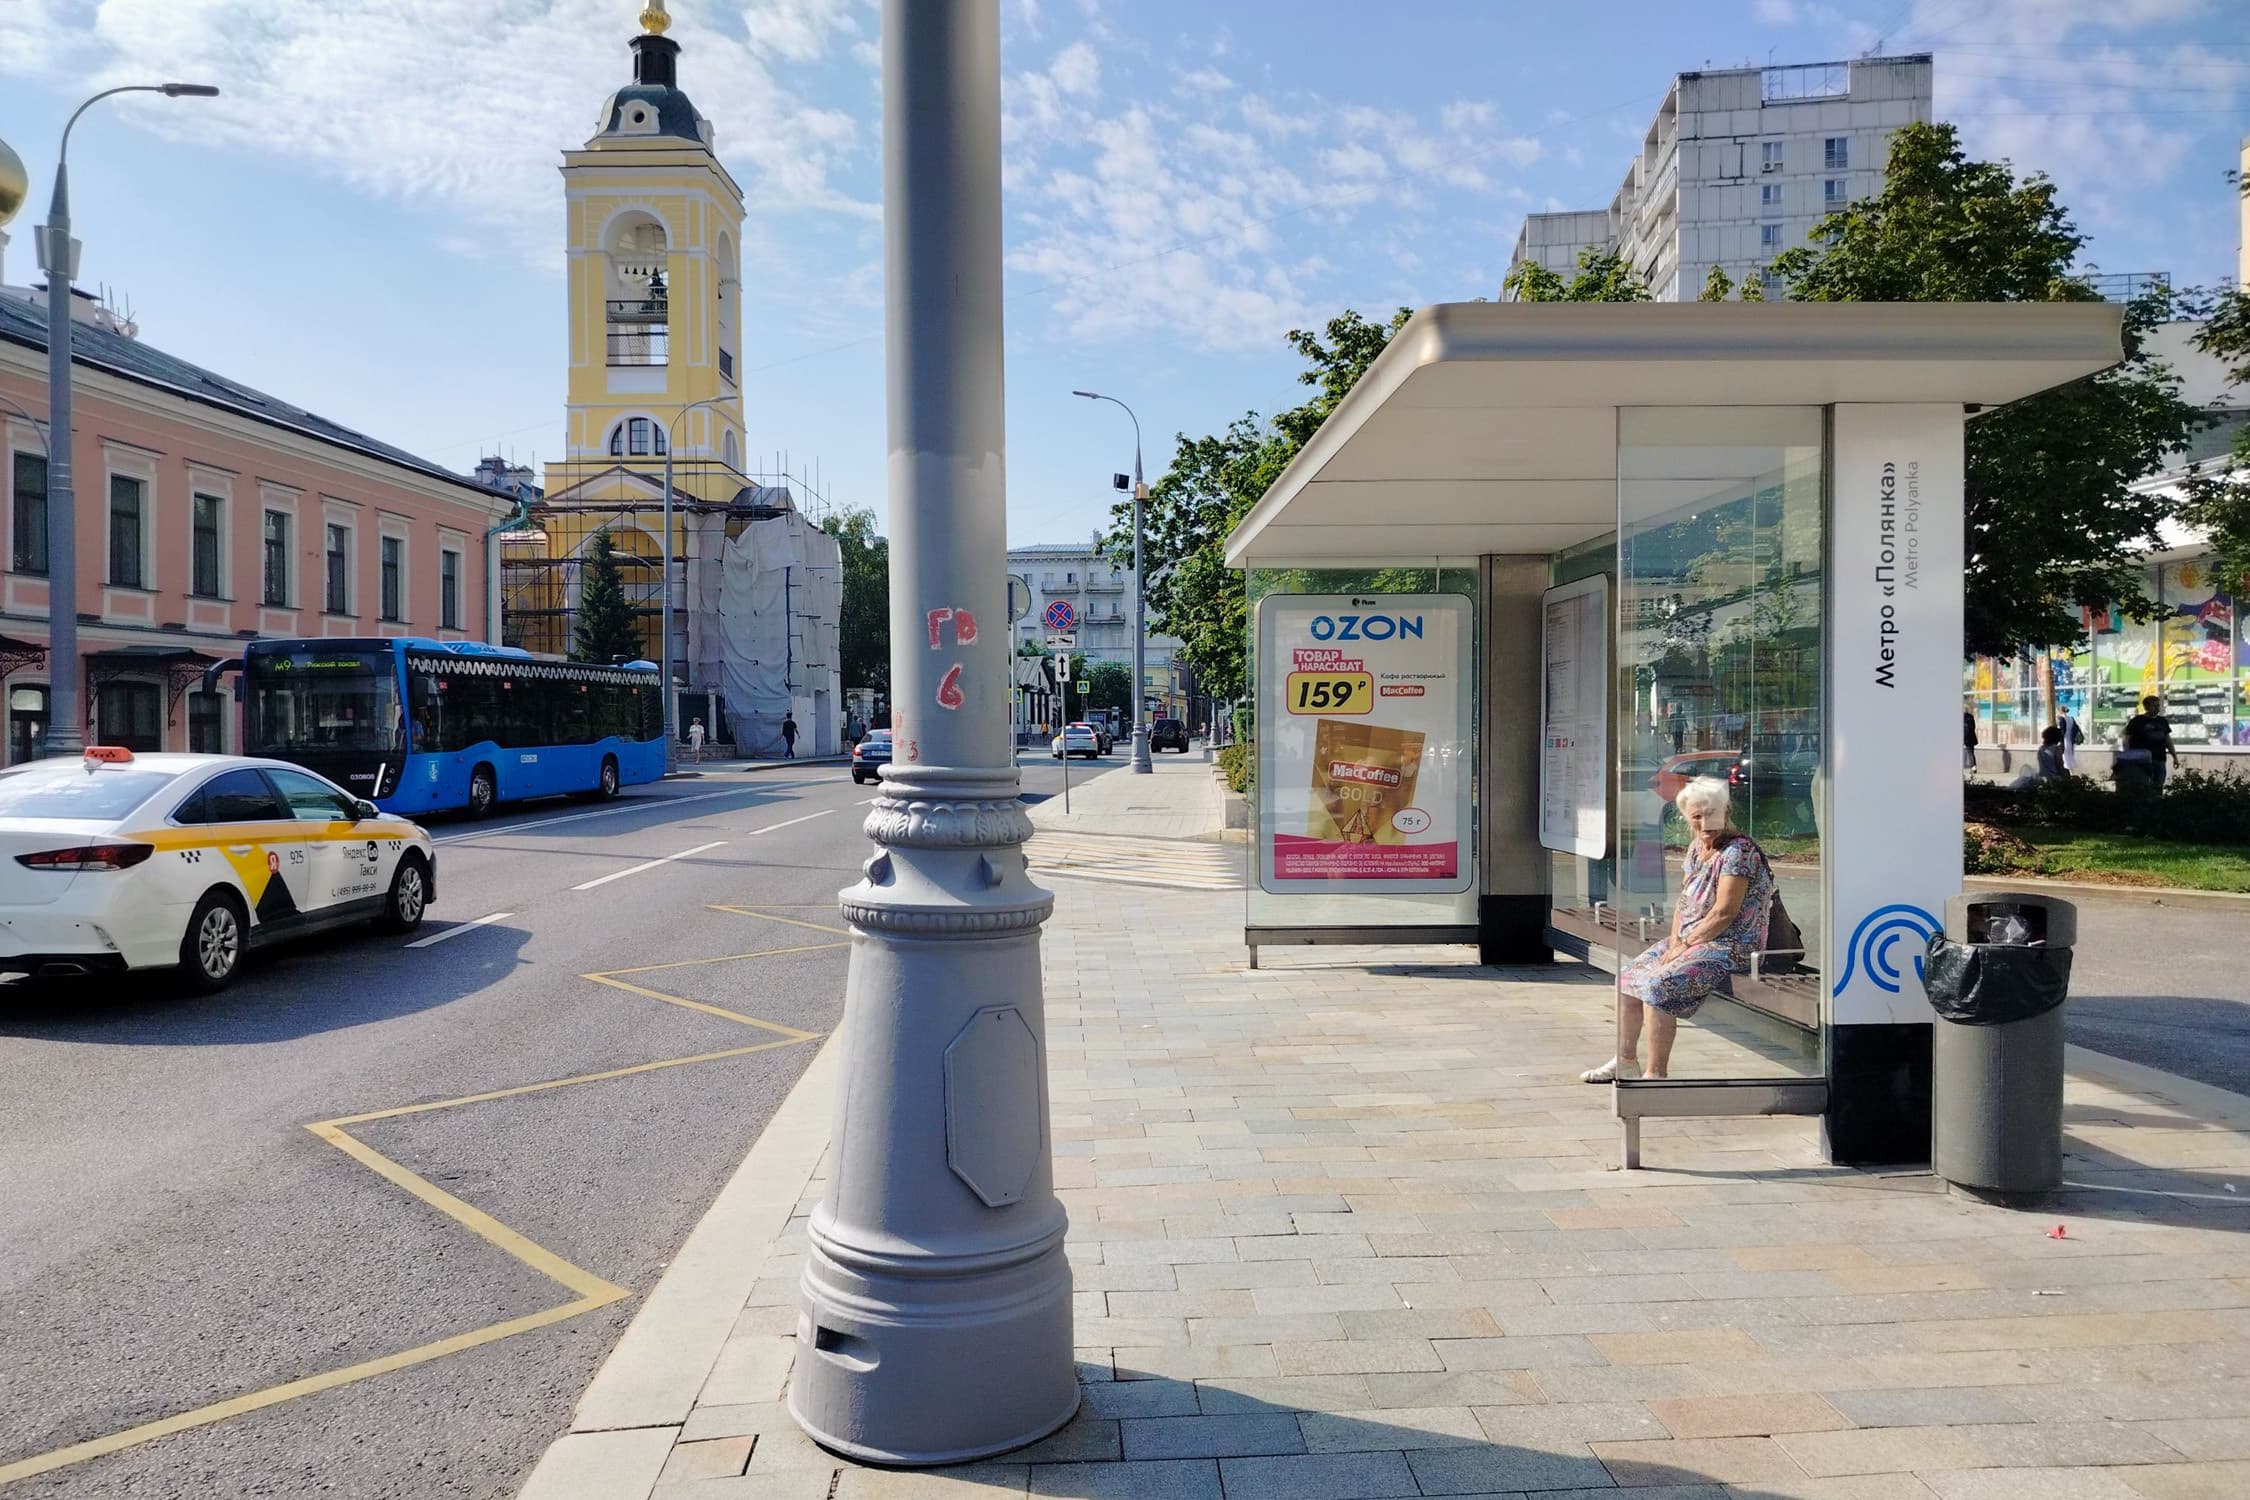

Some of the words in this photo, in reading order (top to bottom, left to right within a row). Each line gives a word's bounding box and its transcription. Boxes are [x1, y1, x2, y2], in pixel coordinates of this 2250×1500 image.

[1904, 461, 1921, 533] Polyanka
[1875, 461, 1895, 597] «Полянка»
[1904, 538, 1919, 590] Metro
[1310, 615, 1423, 641] OZON
[1875, 604, 1899, 689] Метро
[1296, 651, 1339, 662] ТОВАР
[1301, 662, 1362, 672] НАРАСХВАТ
[936, 663, 965, 710] 6
[1299, 681, 1353, 708] 159
[1382, 687, 1424, 695] MacCoffee
[1333, 763, 1399, 784] MacCoffee
[1340, 786, 1383, 804] GOLD
[1402, 817, 1413, 826] 75
[269, 854, 277, 871] Я
[343, 846, 367, 860] Яндекс
[360, 863, 378, 877] Такси
